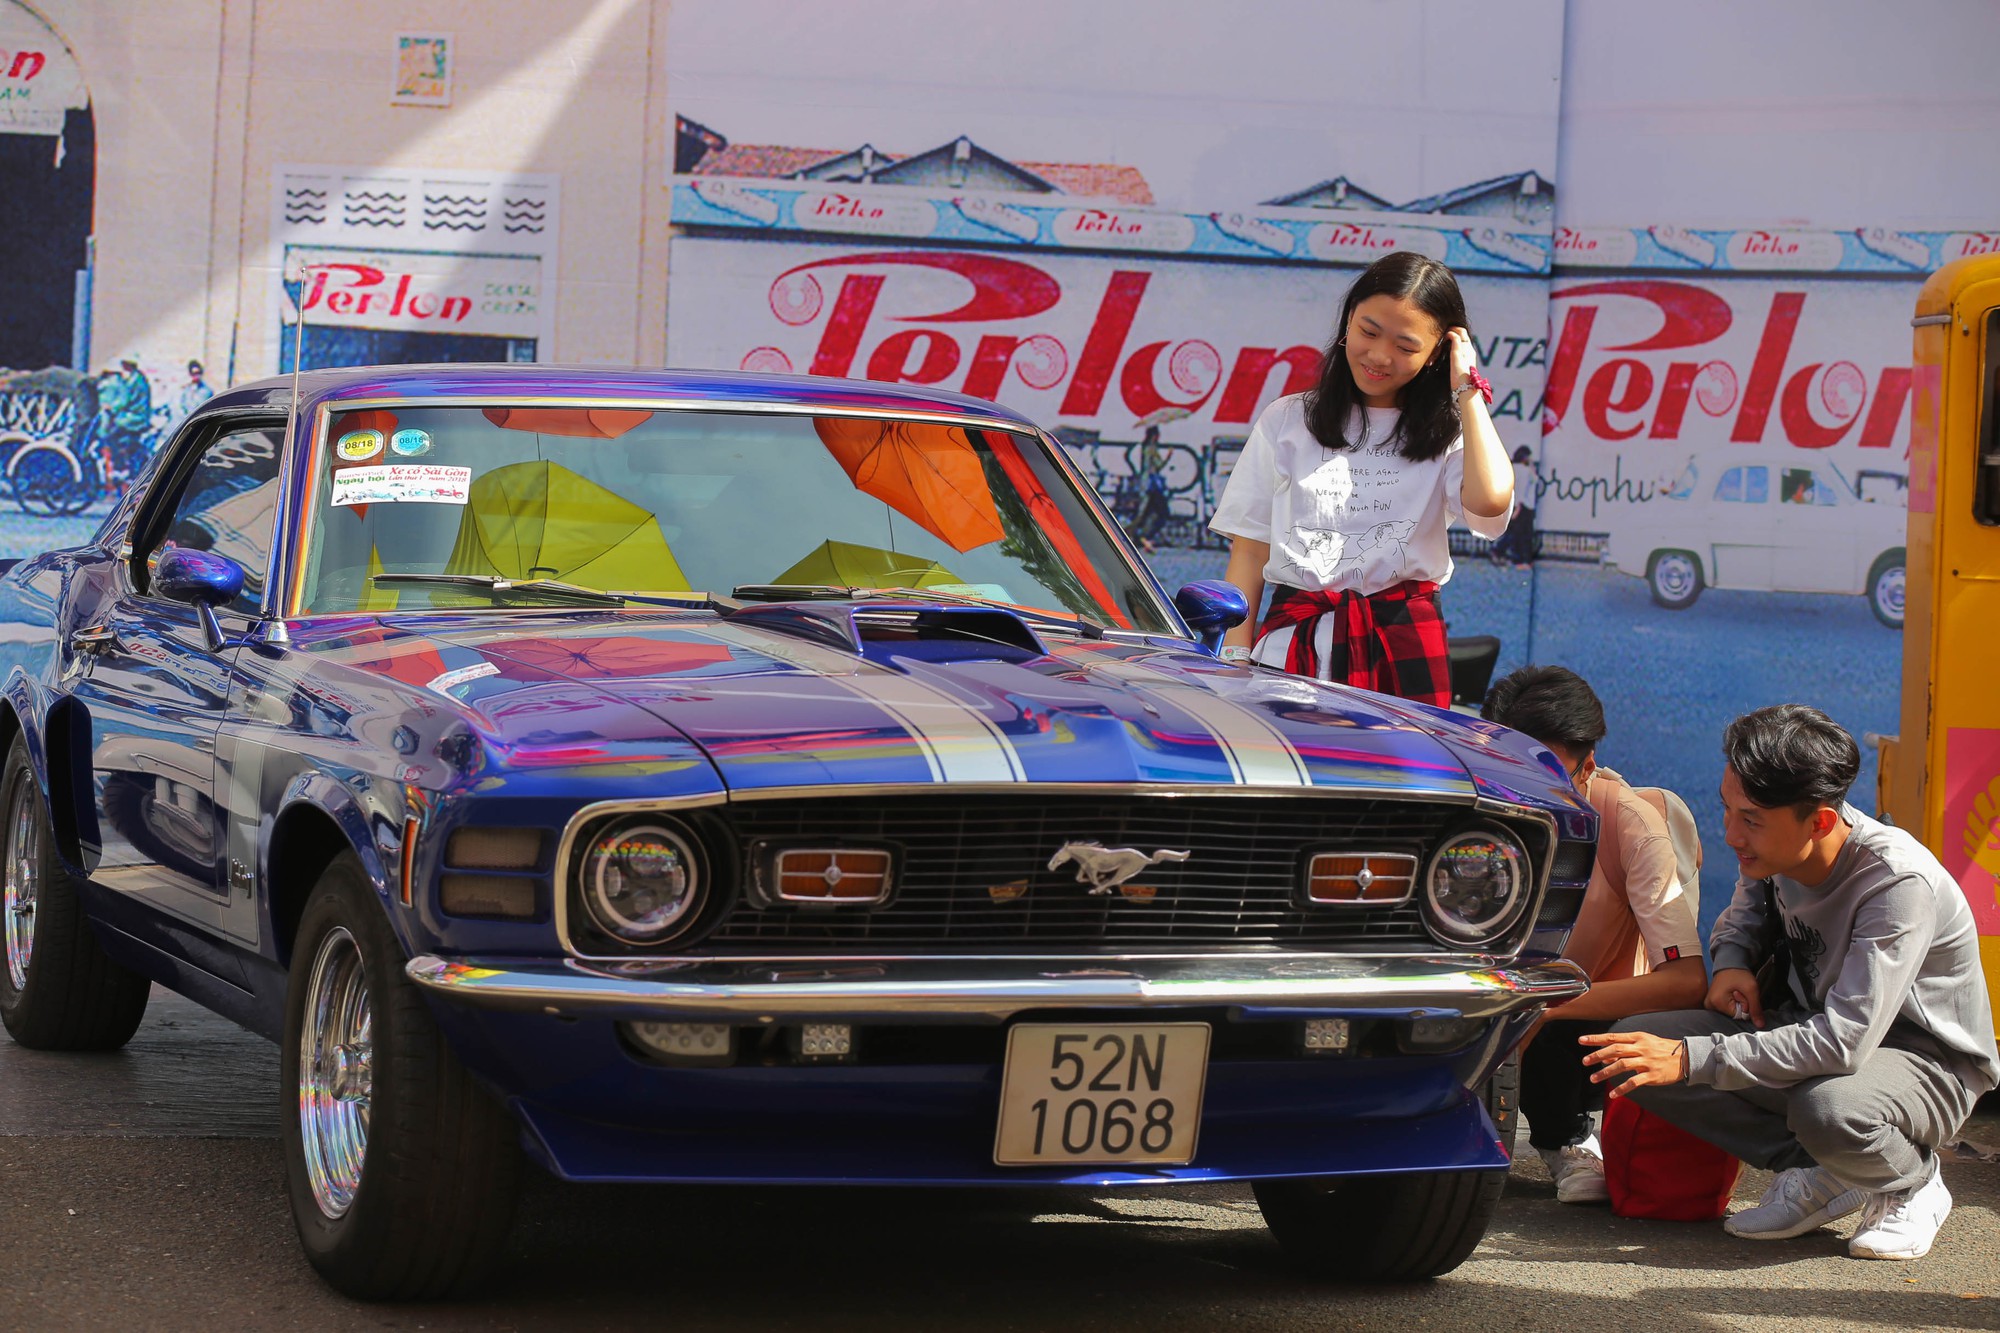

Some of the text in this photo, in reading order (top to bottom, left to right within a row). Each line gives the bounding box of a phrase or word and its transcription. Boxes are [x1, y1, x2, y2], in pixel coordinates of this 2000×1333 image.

[302, 263, 472, 323] Perlon
[741, 251, 1325, 424] Perlon
[1473, 335, 1546, 368] NTA
[345, 440, 374, 449] 08/18
[1366, 448, 1397, 457] NEVER
[389, 466, 405, 475] Xe
[1373, 499, 1392, 513] FUN
[1050, 1034, 1167, 1092] 52N
[1031, 1097, 1175, 1155] 1068
